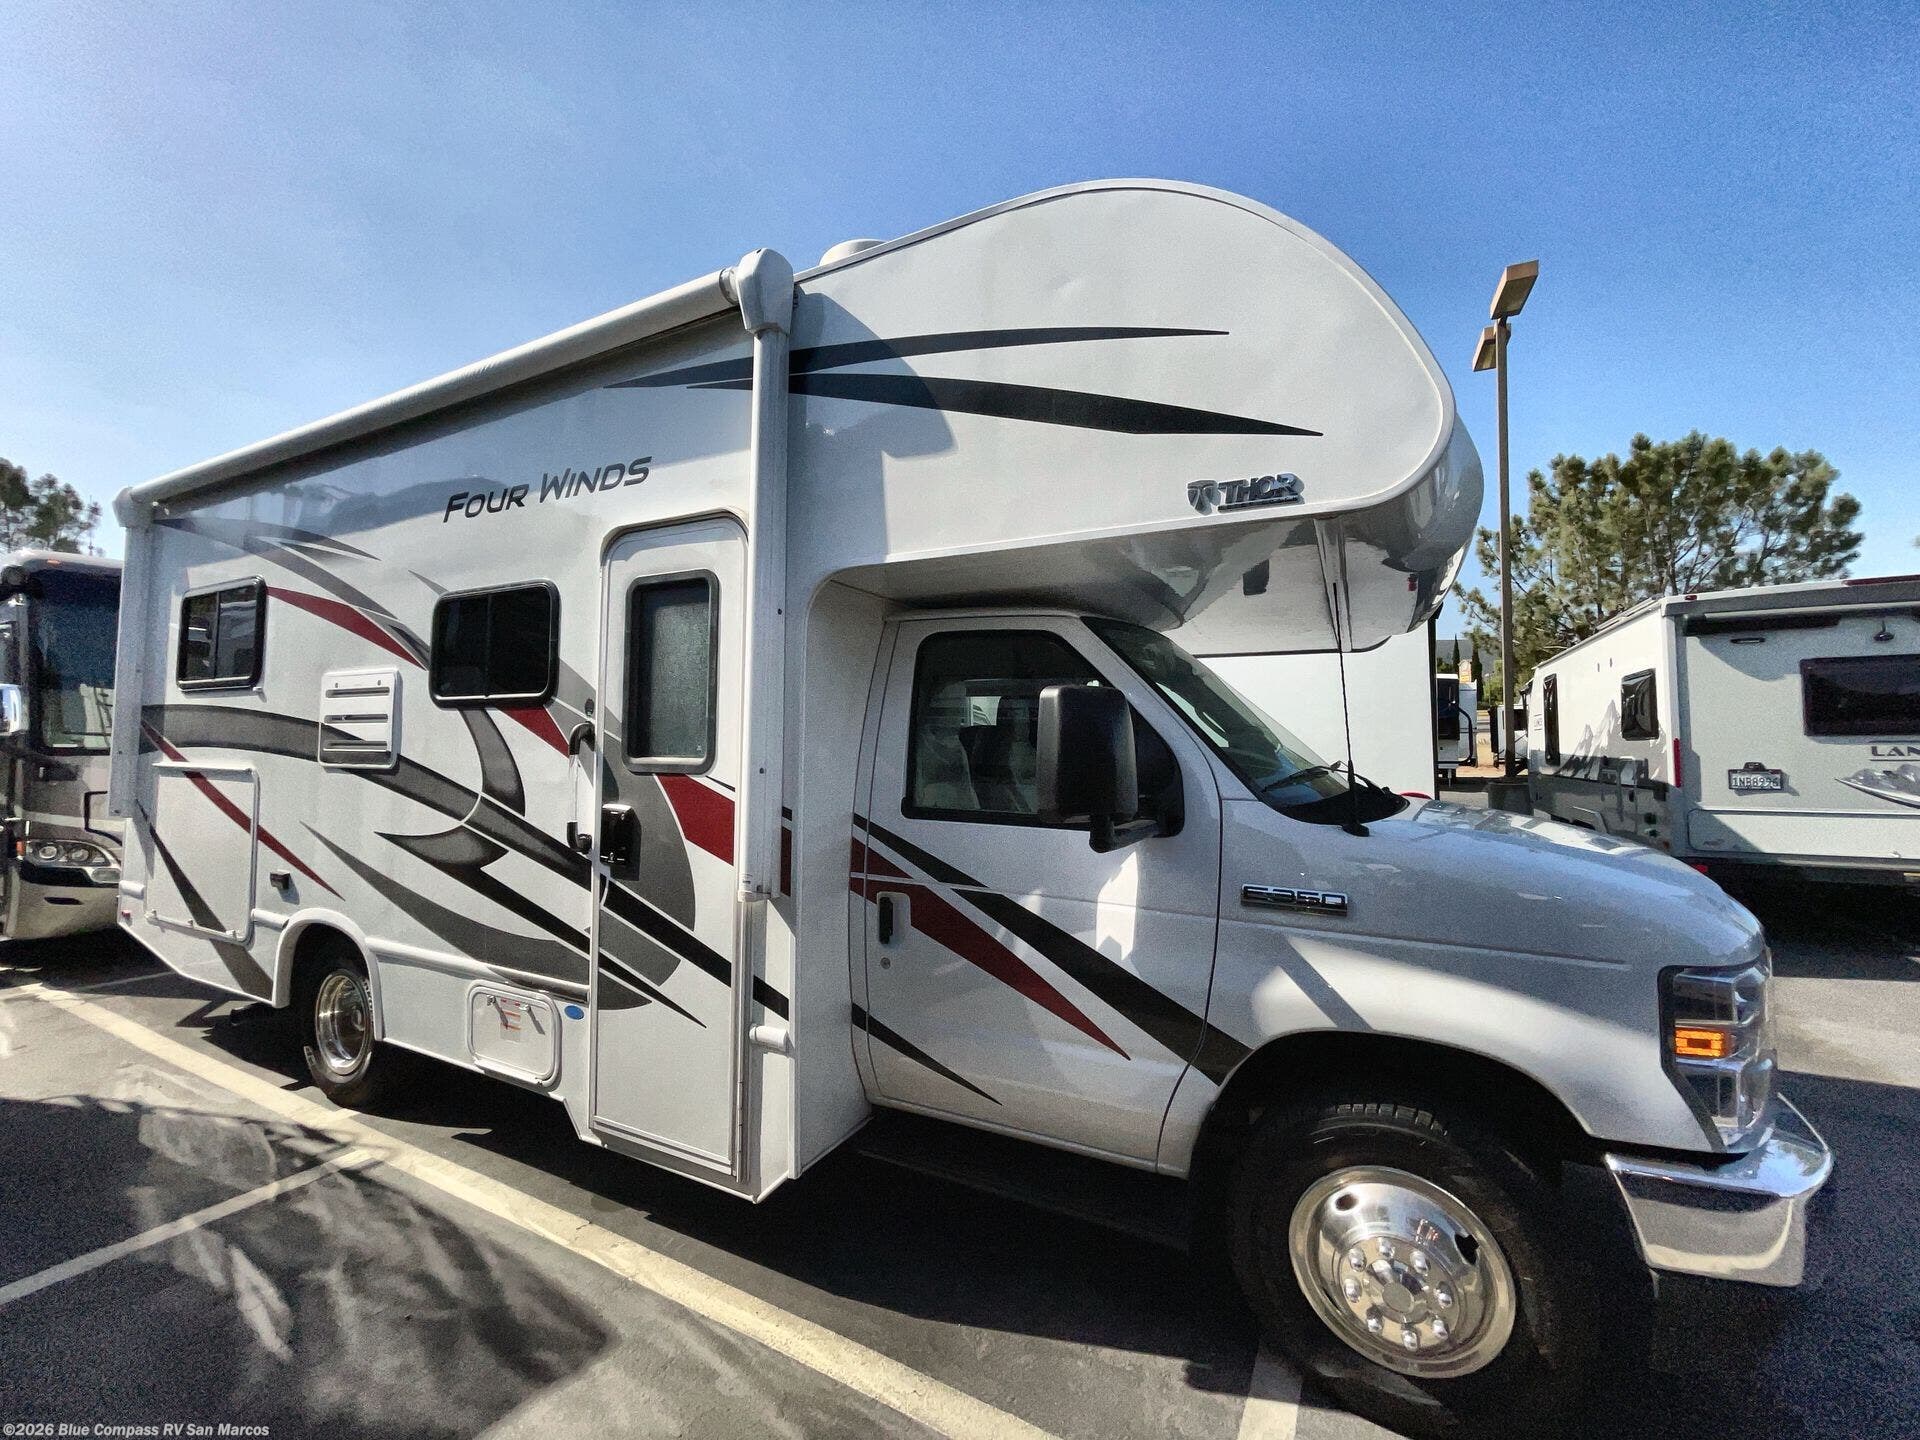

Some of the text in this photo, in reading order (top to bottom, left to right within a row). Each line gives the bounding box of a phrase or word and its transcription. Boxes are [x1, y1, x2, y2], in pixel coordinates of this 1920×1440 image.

[443, 456, 653, 523] FOUR WINDS
[1217, 473, 1305, 504] THOR
